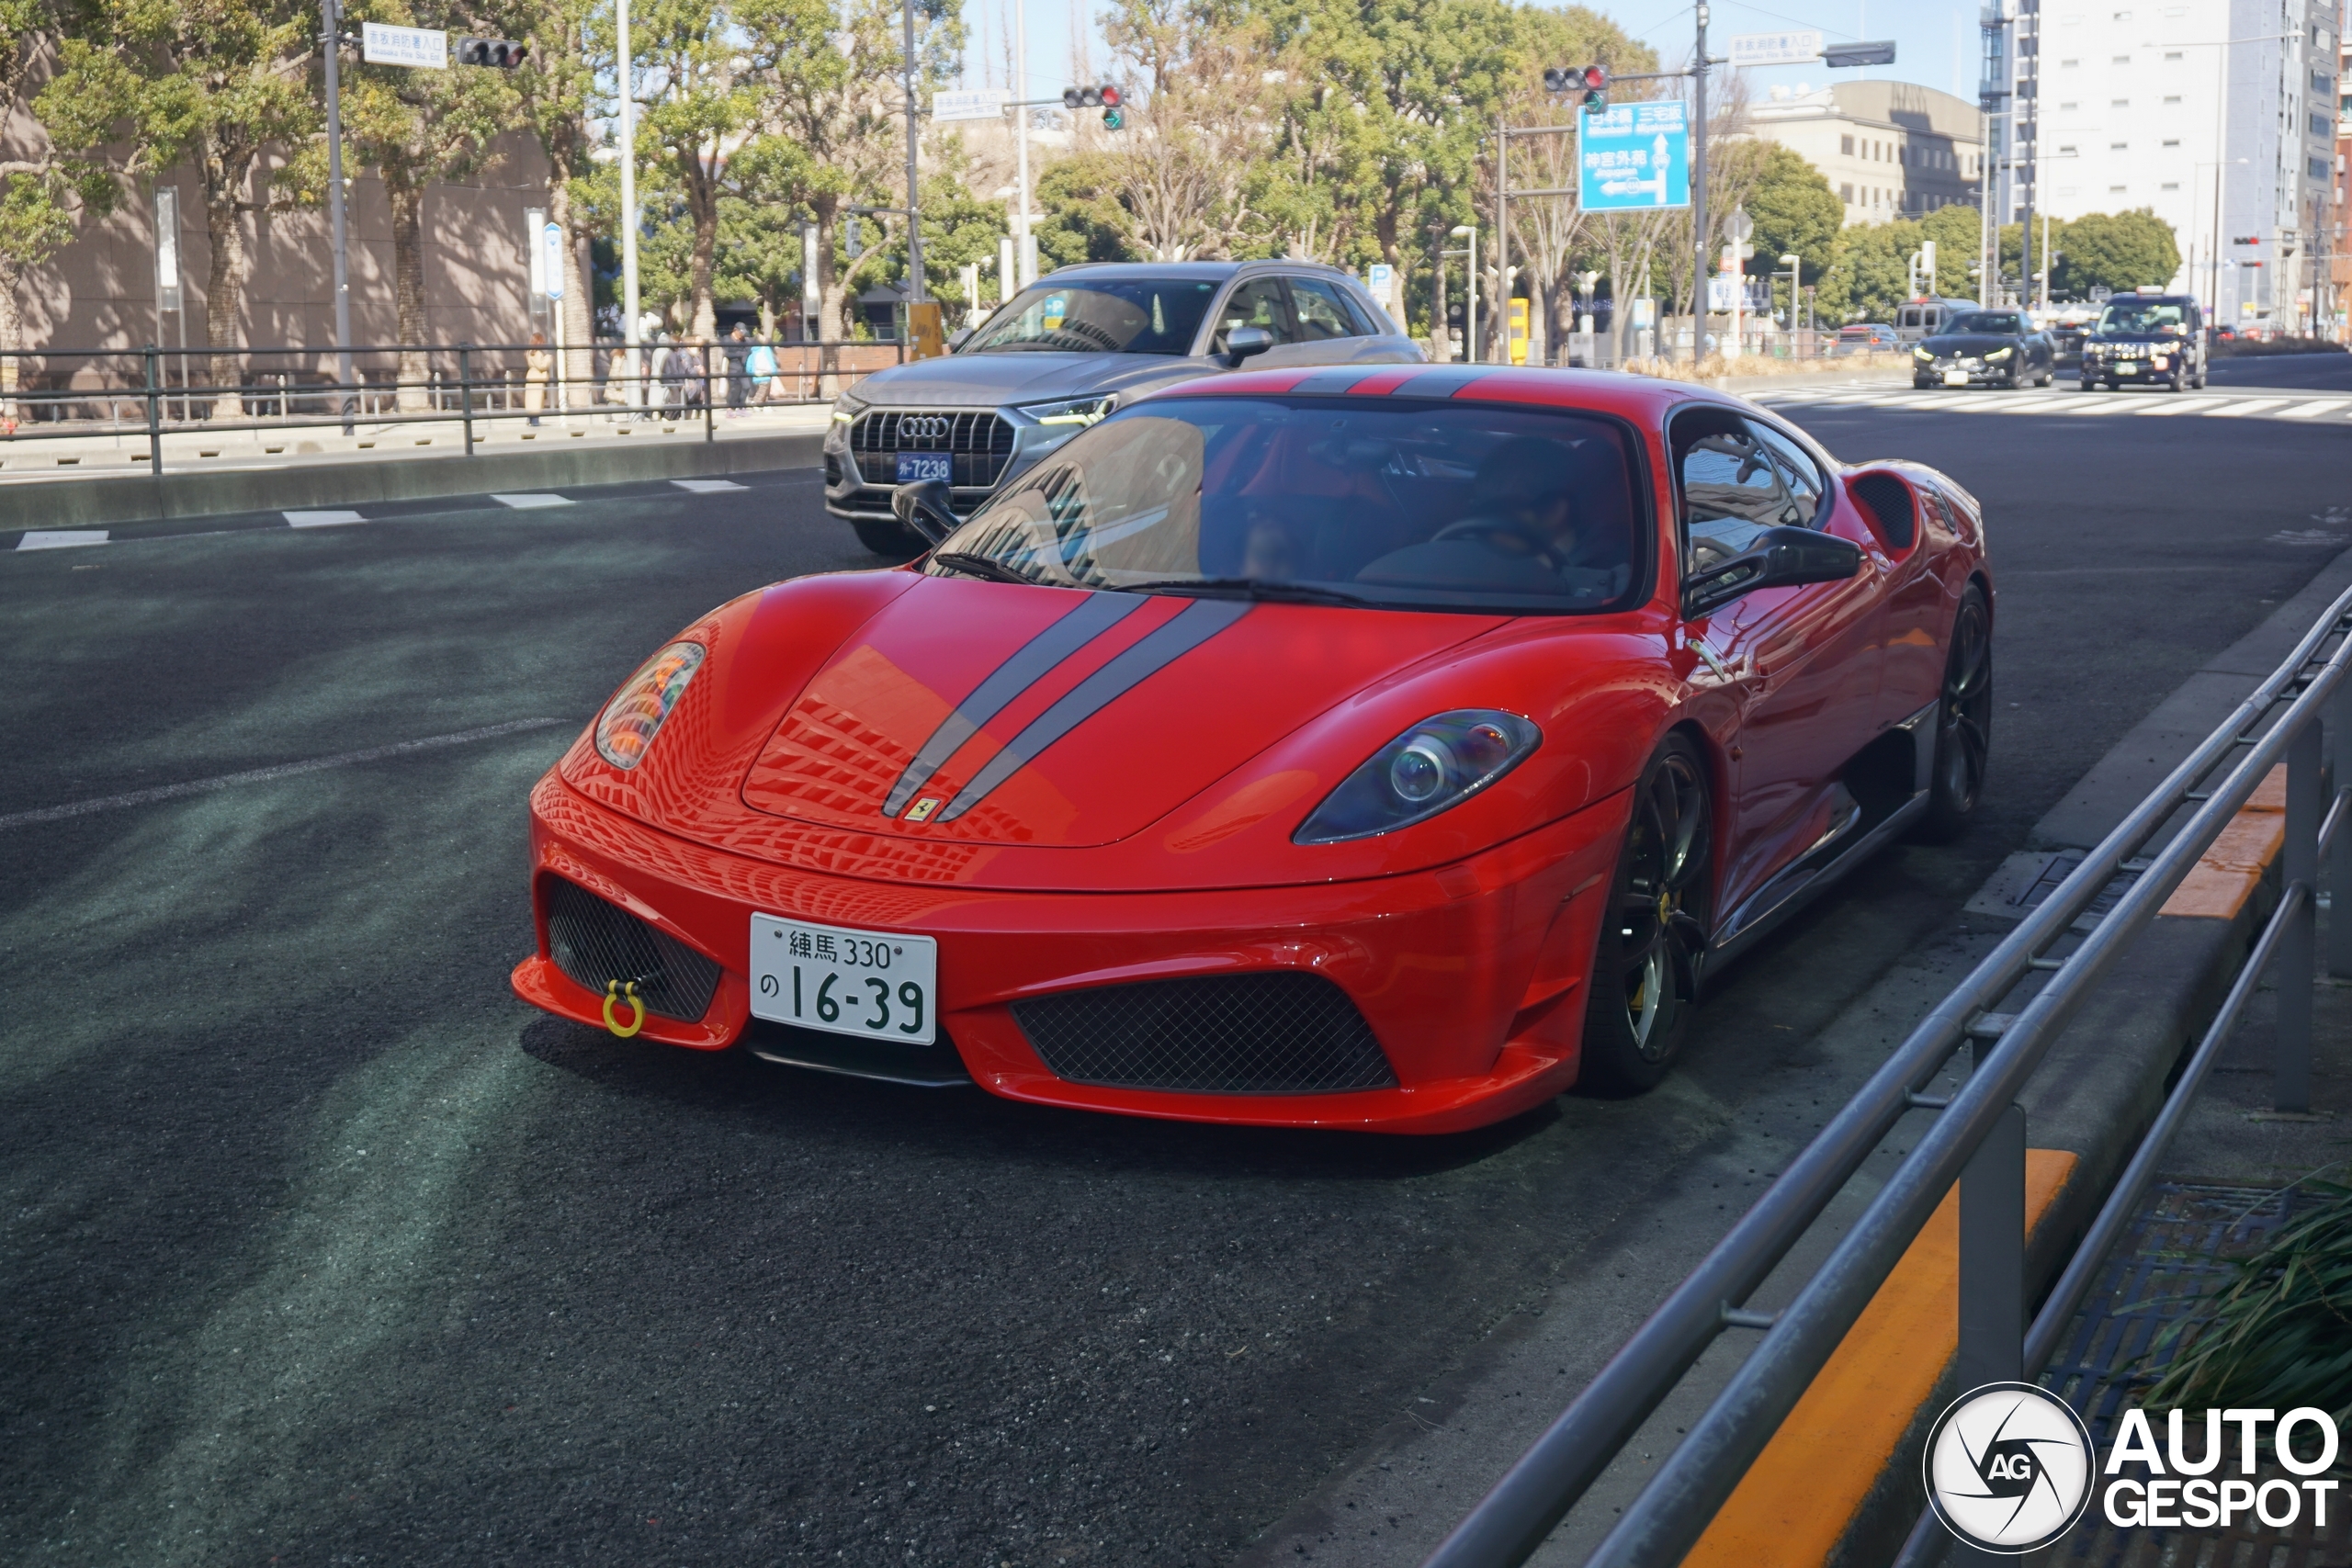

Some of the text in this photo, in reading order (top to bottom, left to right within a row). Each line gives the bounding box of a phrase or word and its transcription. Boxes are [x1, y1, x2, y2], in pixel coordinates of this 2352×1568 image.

[369, 30, 442, 51] 赤坂消防署入口
[1735, 35, 1811, 51] 赤坂消防署入口
[370, 47, 399, 57] Akasaka
[401, 50, 413, 58] Fire
[1638, 105, 1683, 121] 三宅坂
[1585, 150, 1647, 167] 神宮外苑
[1373, 266, 1389, 286] P
[789, 930, 890, 969] 練馬 330
[760, 965, 923, 1034] の 16-39
